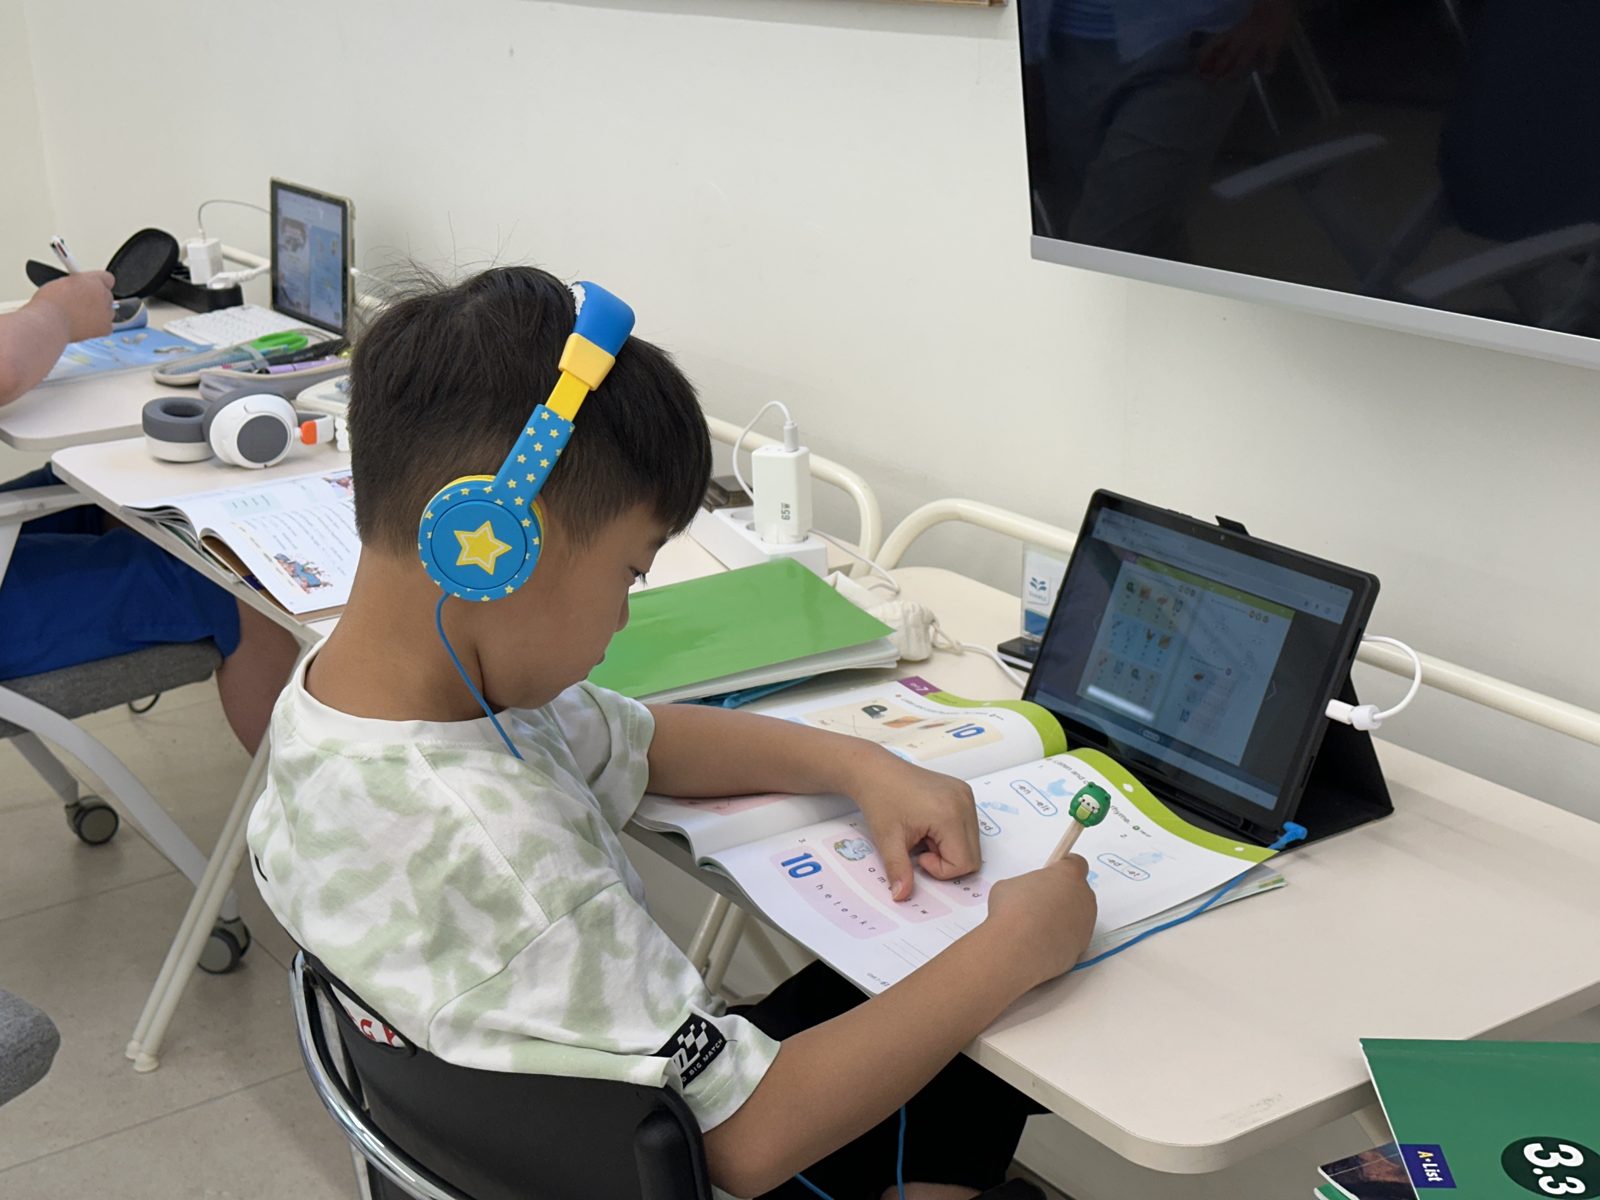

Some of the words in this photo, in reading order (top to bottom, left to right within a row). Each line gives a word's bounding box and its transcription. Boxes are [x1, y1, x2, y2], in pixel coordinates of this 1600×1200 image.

[780, 502, 791, 521] 65W
[946, 723, 985, 739] 10
[780, 852, 822, 879] 10
[688, 1062, 703, 1076] BIG
[702, 1038, 724, 1062] MATCH
[1523, 1142, 1586, 1196] 3.3
